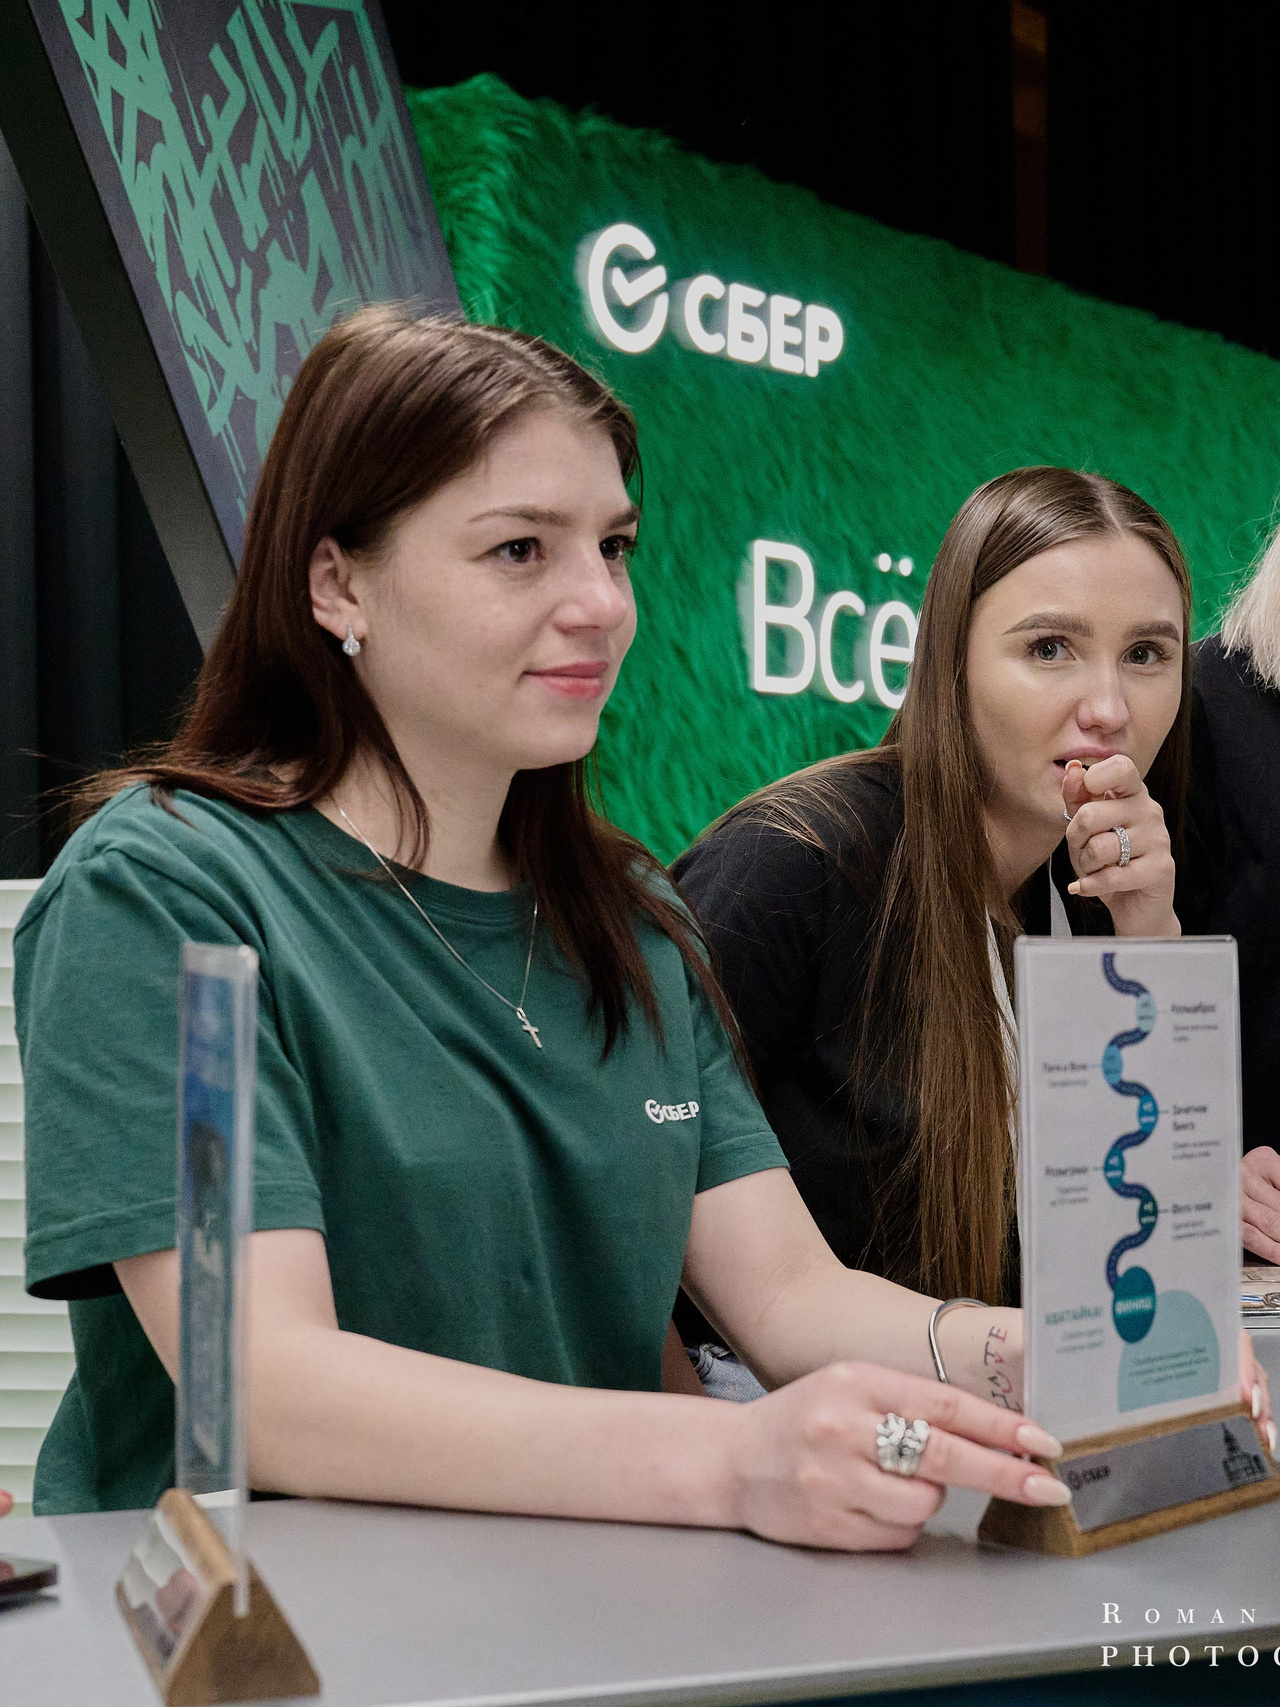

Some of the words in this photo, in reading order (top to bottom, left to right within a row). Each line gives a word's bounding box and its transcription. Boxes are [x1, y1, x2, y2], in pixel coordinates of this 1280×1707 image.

[684, 274, 845, 378] СБЕР
[753, 539, 919, 709] Всё
[662, 1101, 700, 1121] СБЕР
